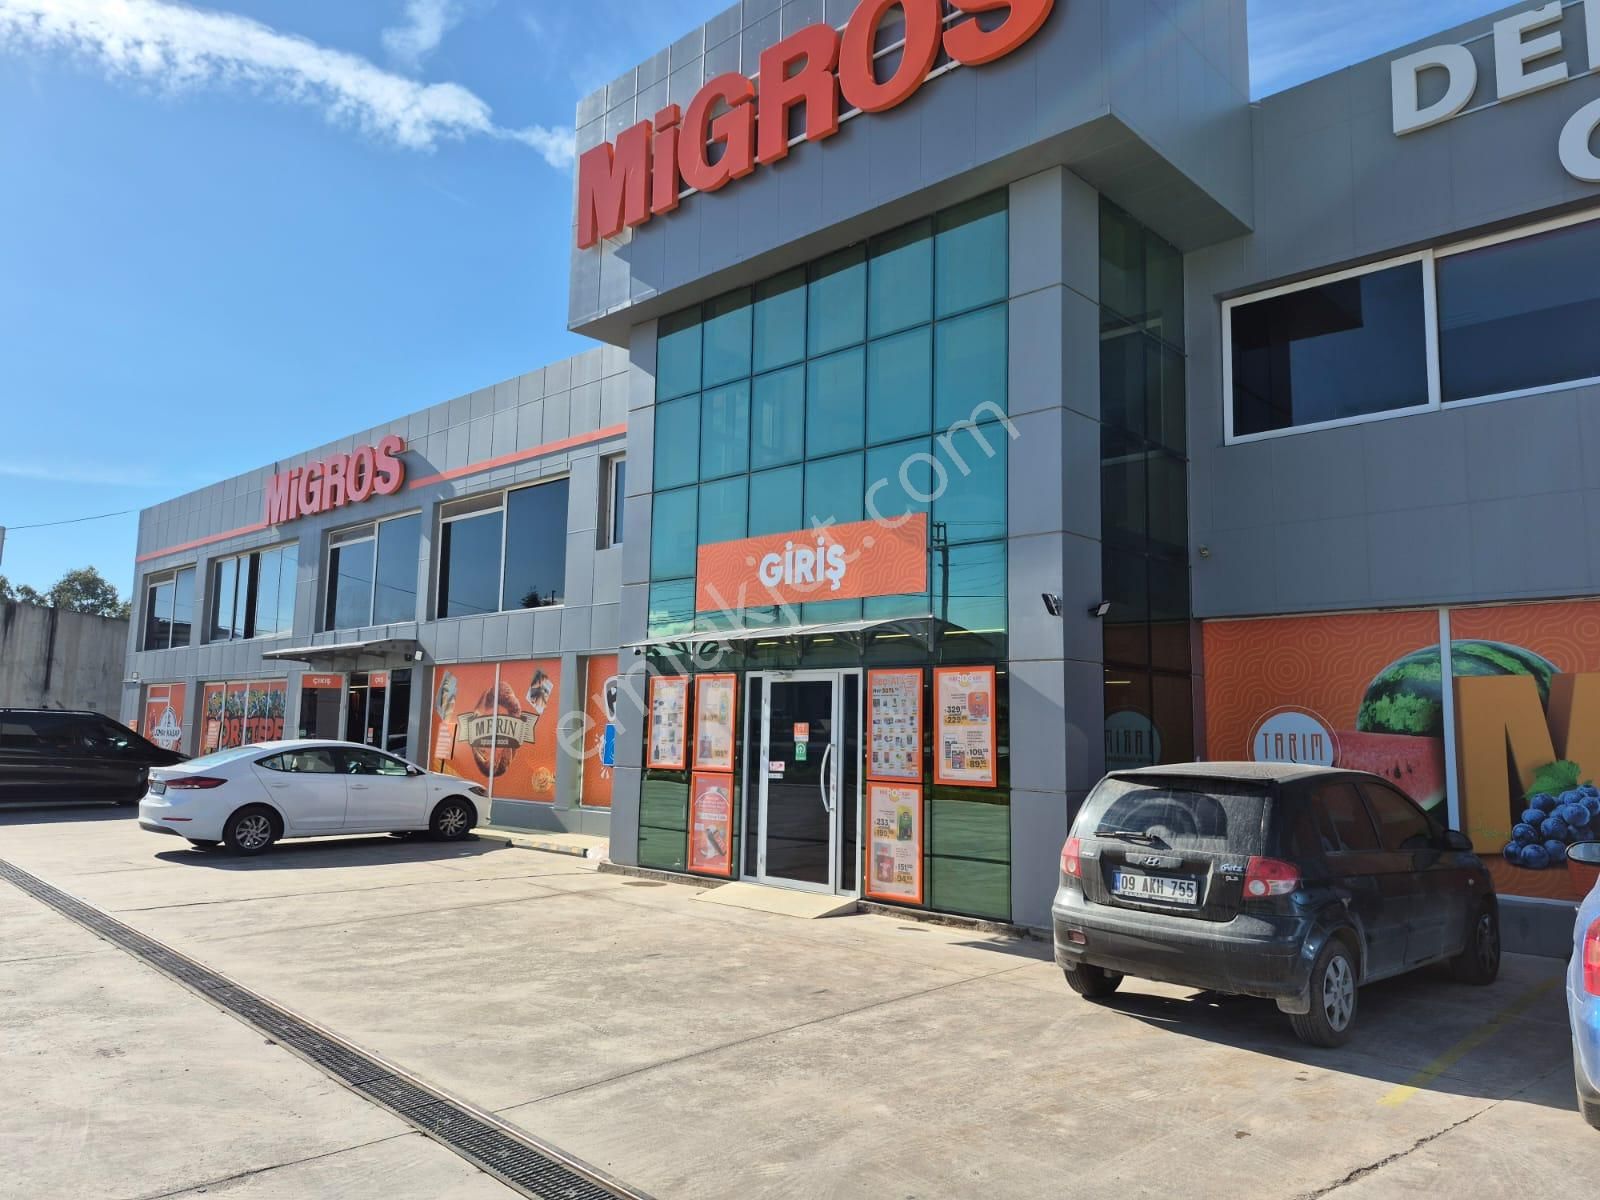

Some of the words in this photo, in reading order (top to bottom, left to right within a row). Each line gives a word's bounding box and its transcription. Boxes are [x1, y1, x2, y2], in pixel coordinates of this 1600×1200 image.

[1391, 0, 1600, 136] DE
[758, 534, 847, 590] GİRİŞ
[1262, 732, 1324, 763] TARIM
[1121, 875, 1136, 891] 09
[1142, 878, 1164, 895] AKH
[1170, 880, 1194, 898] 755
